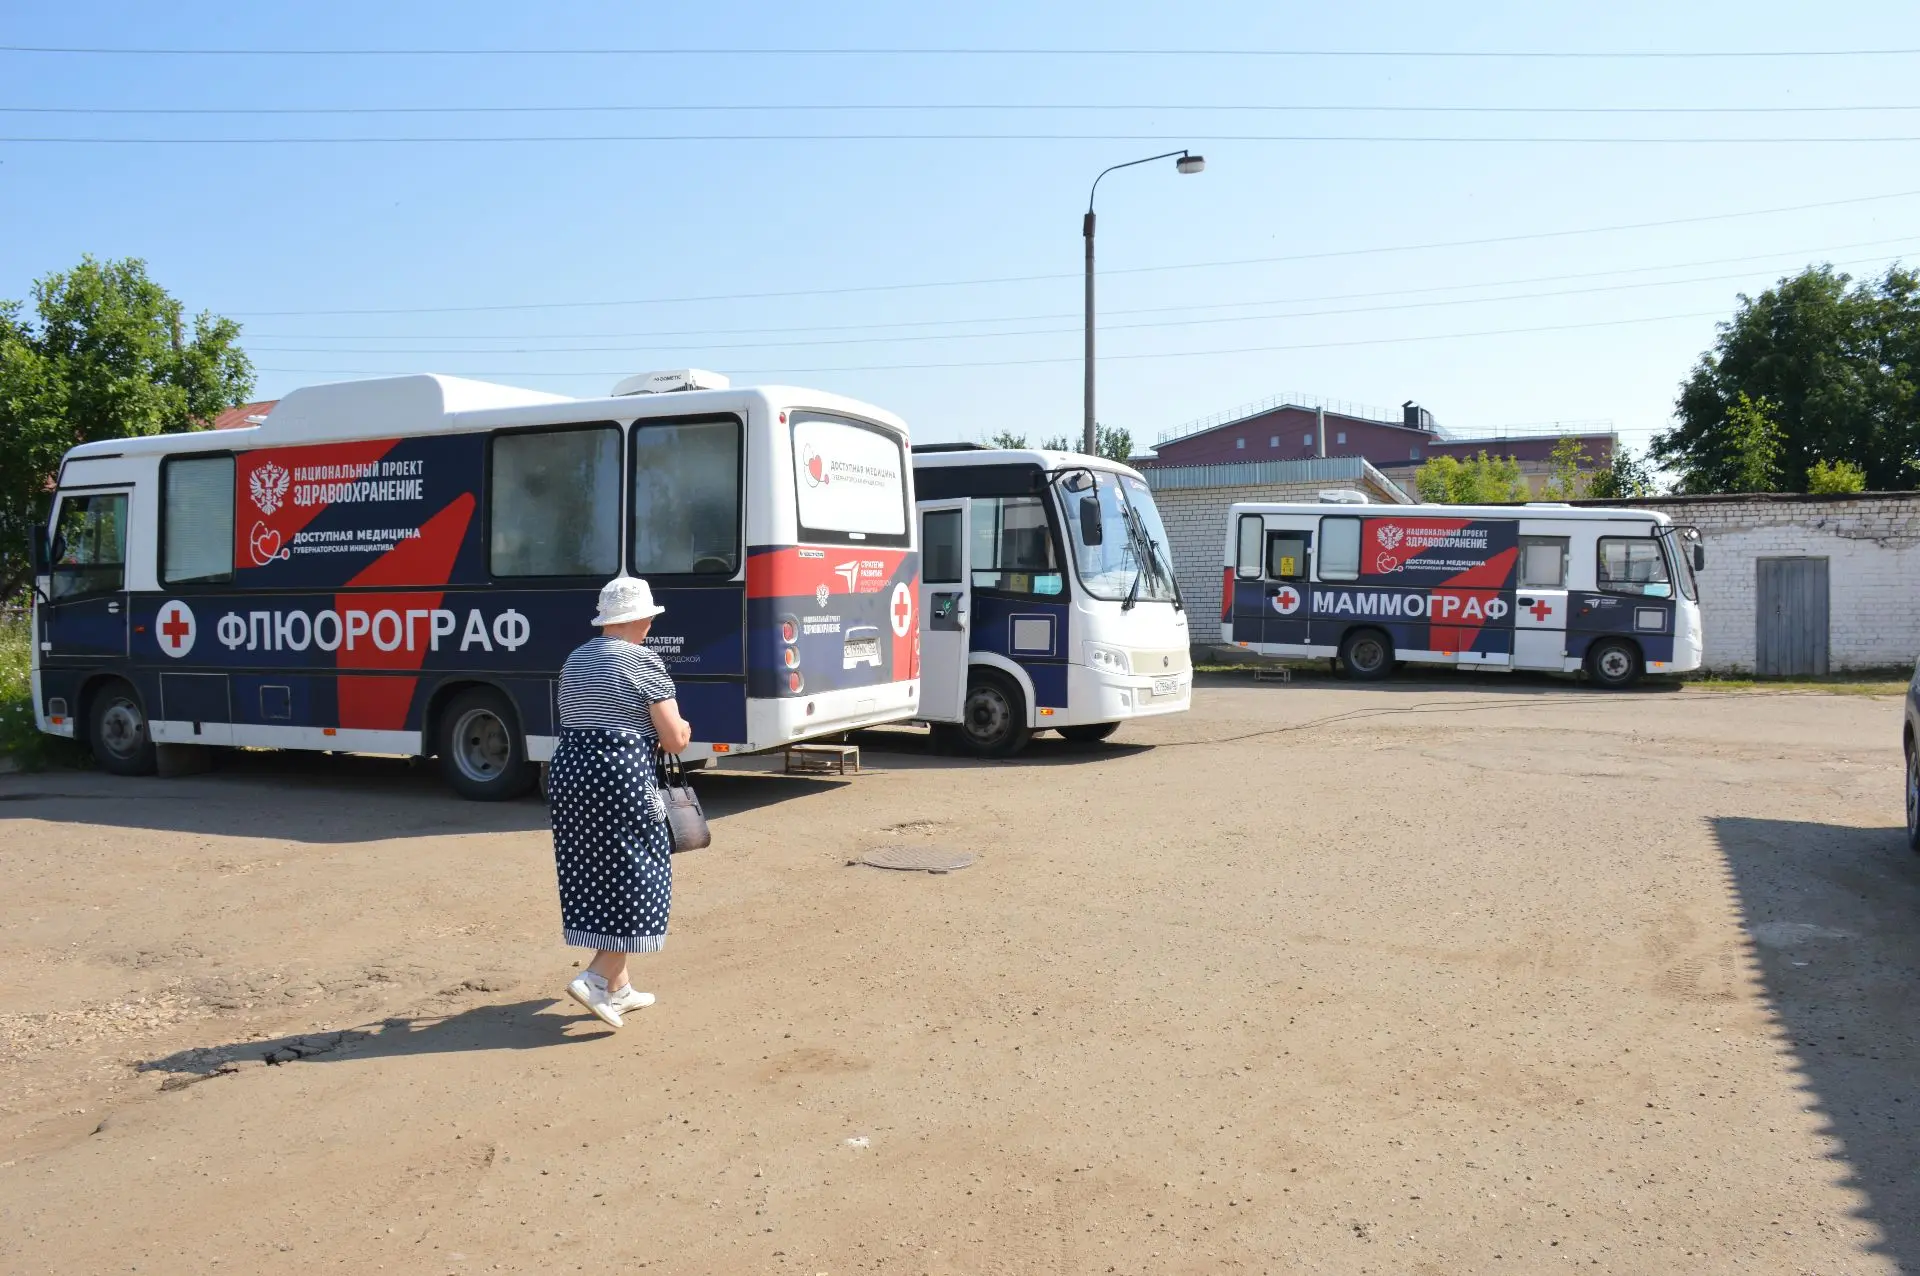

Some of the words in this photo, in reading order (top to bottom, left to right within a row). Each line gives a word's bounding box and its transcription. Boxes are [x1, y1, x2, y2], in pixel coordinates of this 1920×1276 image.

[294, 461, 379, 481] НАЦИОНАЛЬНЫЙ
[383, 460, 423, 476] ПРОЕКТ
[830, 460, 863, 474] ДОСТУПНАЯ
[866, 466, 896, 480] МЕДИЦИНА
[294, 479, 423, 506] ЗДРАВООХРАНЕНИЕ
[293, 530, 353, 544] ДОСТУПНАЯ
[357, 528, 421, 541] МЕДИЦИНА
[1406, 528, 1460, 537] НАЦИОНАЛЬНЫЙ
[1462, 529, 1488, 537] ПРОЕКТ
[293, 545, 349, 554] ГУБЕРНАТОРСКАЯ
[350, 543, 394, 552] ИНИЦИАТИВА
[1406, 537, 1488, 549] ЗДРАВООХРАНЕНИЕ
[1313, 591, 1509, 620] МАММОГРАФ
[217, 608, 531, 652] ФЛЮОРОГРАФ
